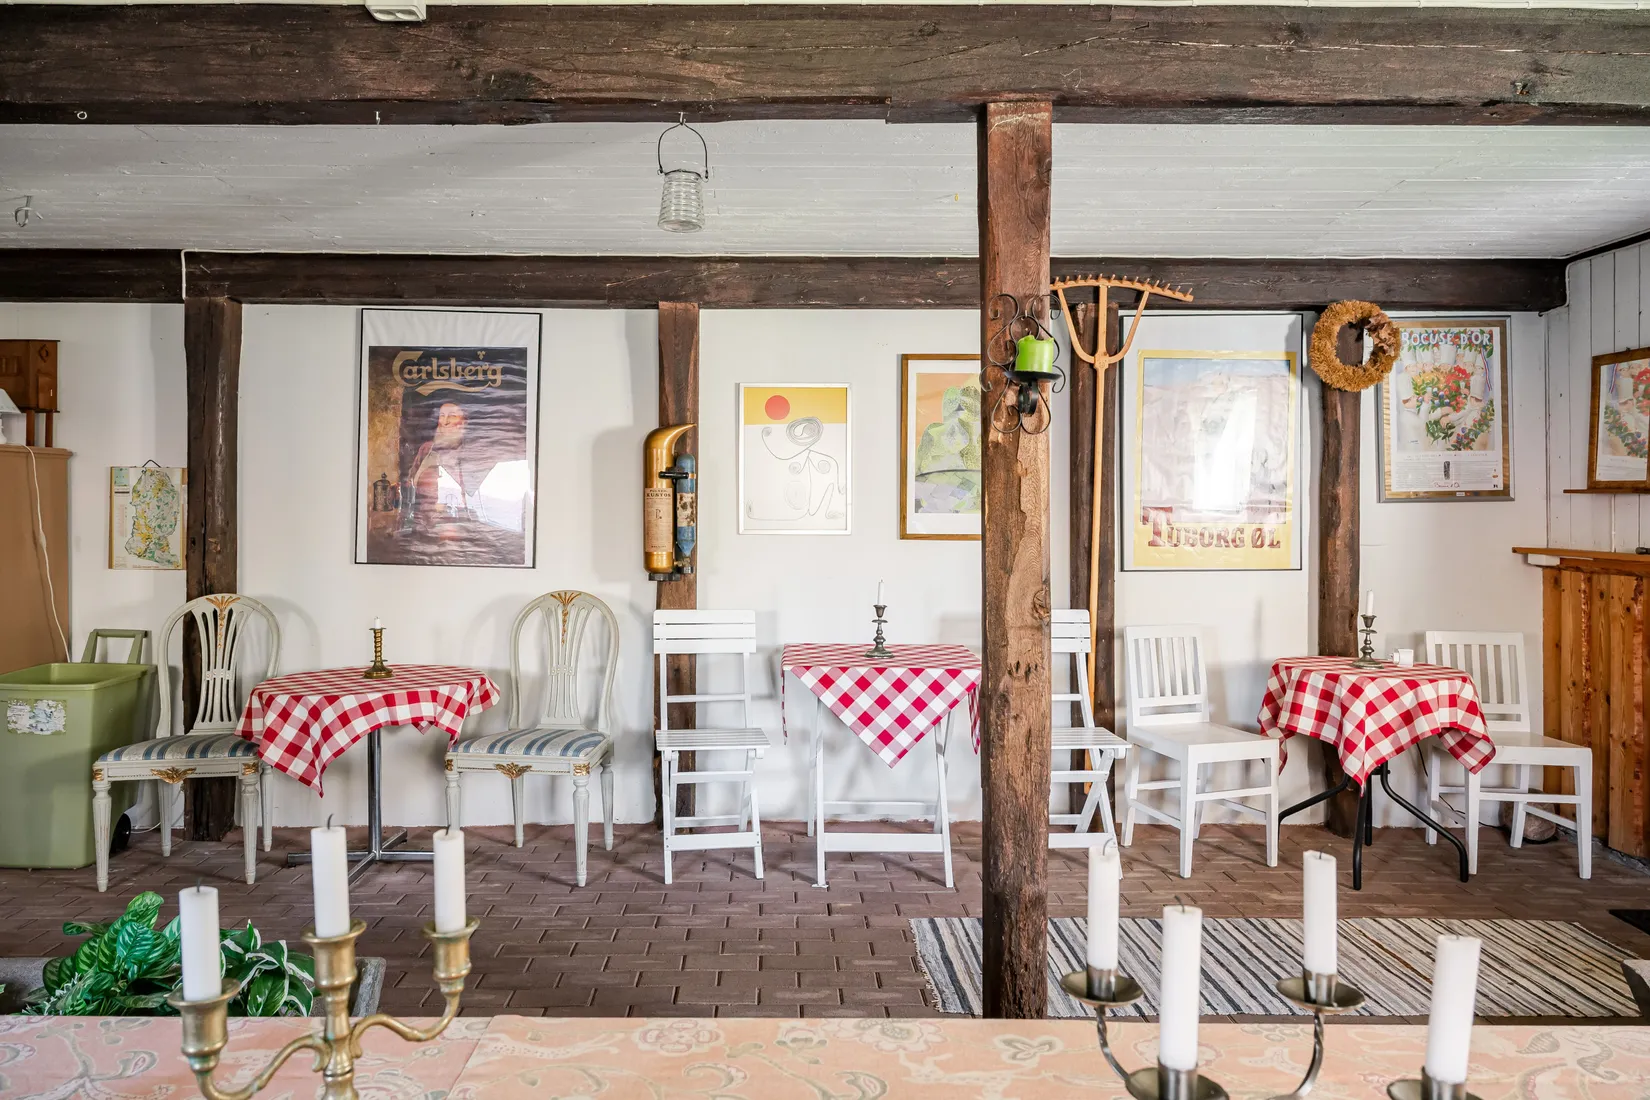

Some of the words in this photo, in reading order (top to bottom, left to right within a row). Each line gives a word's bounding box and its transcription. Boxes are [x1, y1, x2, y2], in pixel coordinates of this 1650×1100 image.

[1402, 332, 1454, 346] BOCUSE
[1460, 331, 1491, 346] D'OR
[392, 350, 504, 395] Carlsberg
[1142, 505, 1246, 549] TUBORG
[1251, 527, 1281, 549] ØL
